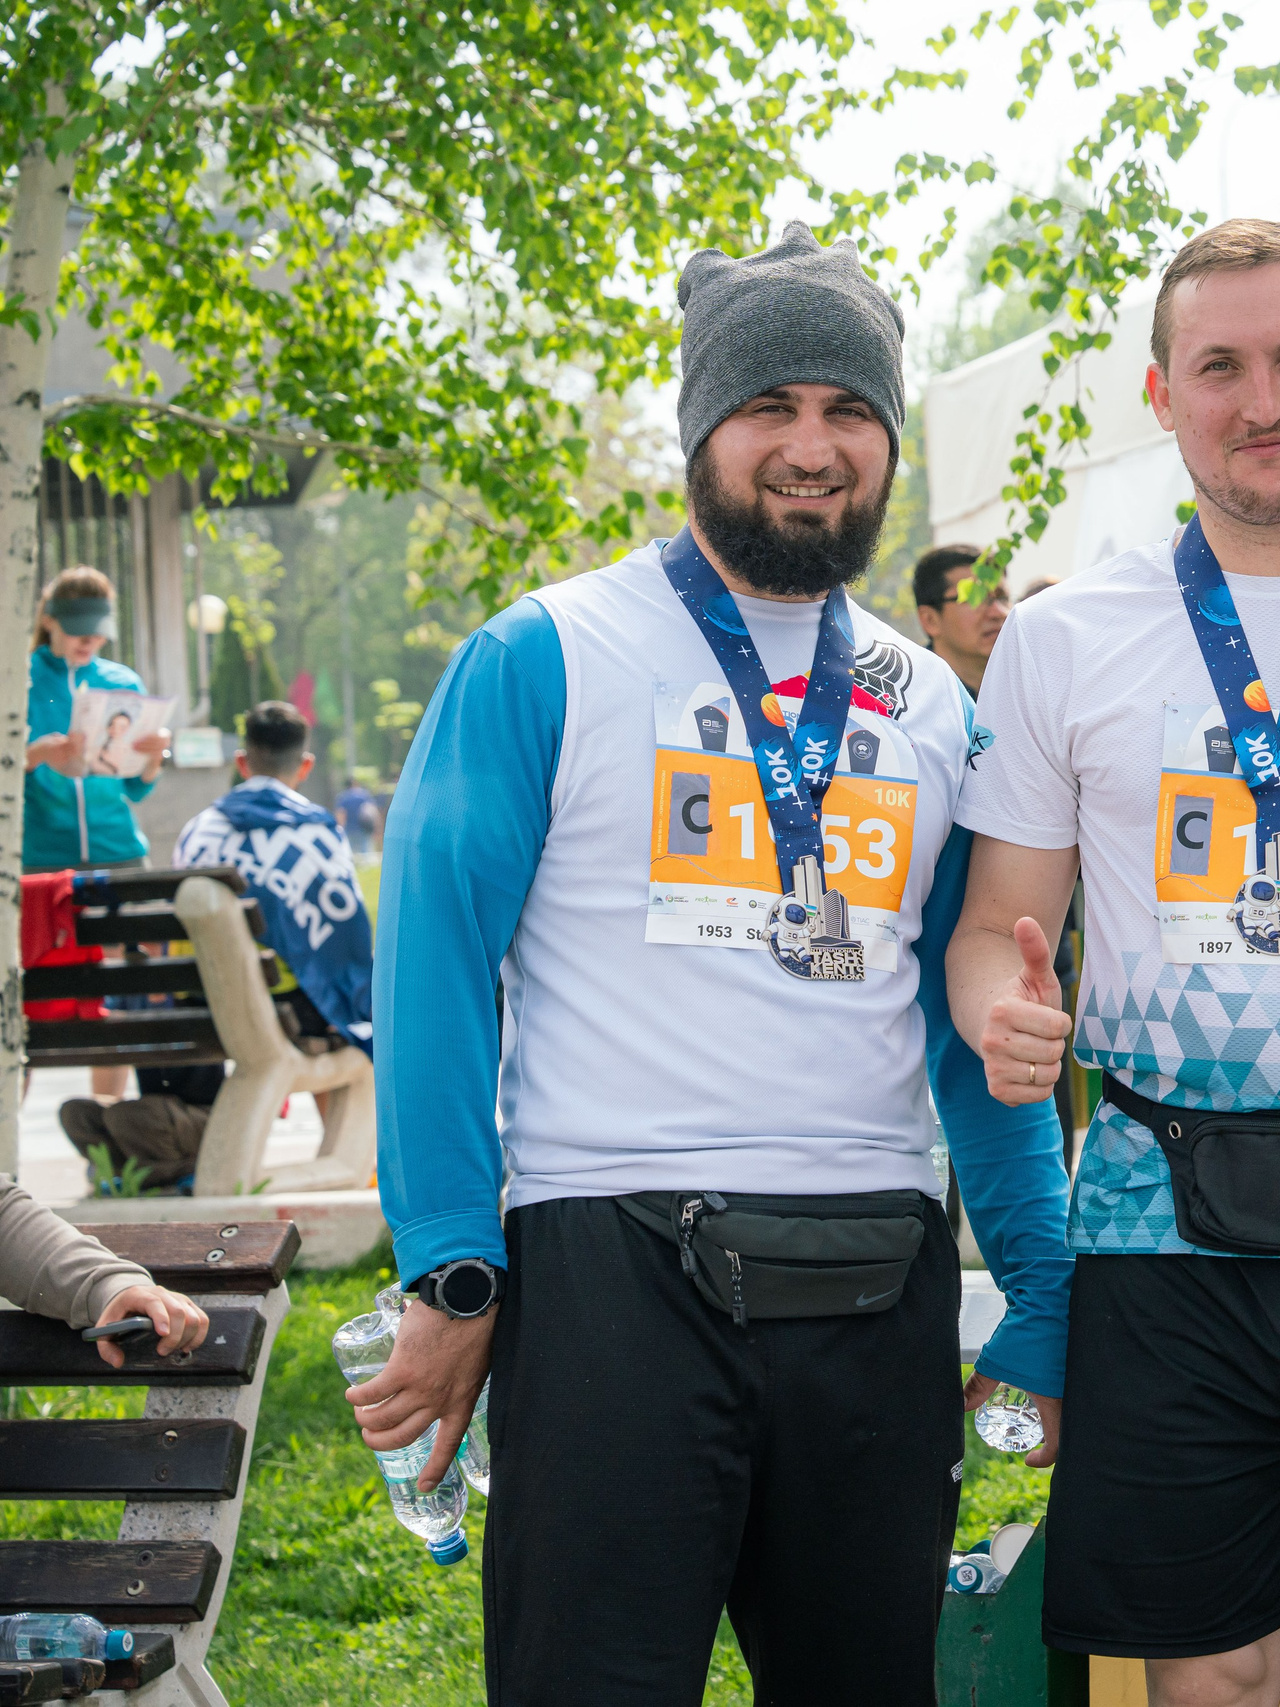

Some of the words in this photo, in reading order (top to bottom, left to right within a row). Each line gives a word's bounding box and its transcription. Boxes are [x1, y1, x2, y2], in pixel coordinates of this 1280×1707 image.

[764, 747, 799, 800] 10K
[801, 736, 829, 785] 10K
[1245, 731, 1280, 783] 10K
[682, 794, 713, 835] C
[874, 788, 911, 808] 10K
[728, 801, 897, 879] 153
[1176, 810, 1208, 850] C
[697, 924, 732, 938] 1953
[1199, 942, 1233, 954] 1897
[810, 961, 857, 976] KENT
[811, 951, 859, 965] TASH
